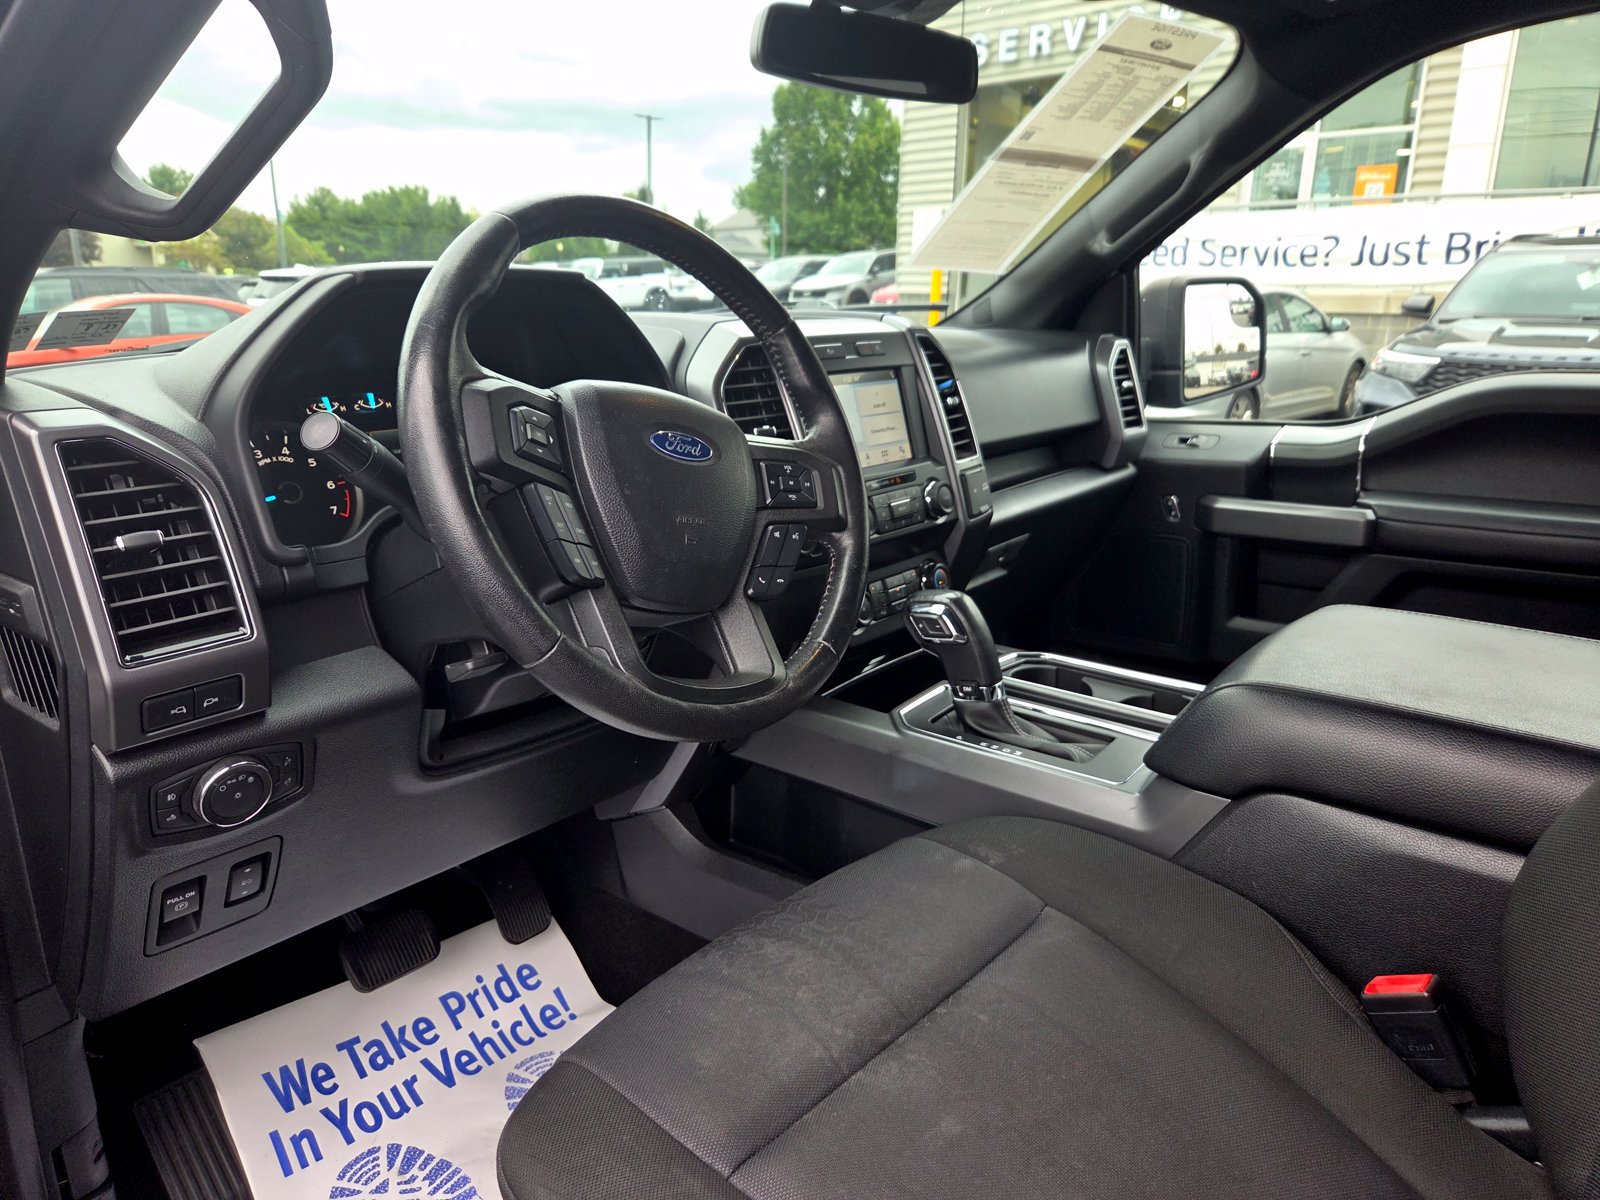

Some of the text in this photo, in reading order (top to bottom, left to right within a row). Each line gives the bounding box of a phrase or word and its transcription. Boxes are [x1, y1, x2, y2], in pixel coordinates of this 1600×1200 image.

[1140, 237, 1189, 266] ed
[1198, 235, 1340, 267] Service?
[1350, 234, 1431, 266] Just
[665, 432, 702, 457] Ford
[254, 449, 263, 458] 3
[281, 447, 290, 455] 4
[308, 458, 317, 467] 5
[326, 481, 336, 489] 6
[330, 505, 338, 515] 7
[166, 890, 196, 905] PULL ON
[262, 963, 542, 1113] We Take Pride
[268, 987, 579, 1178] In Your Vehicle!
